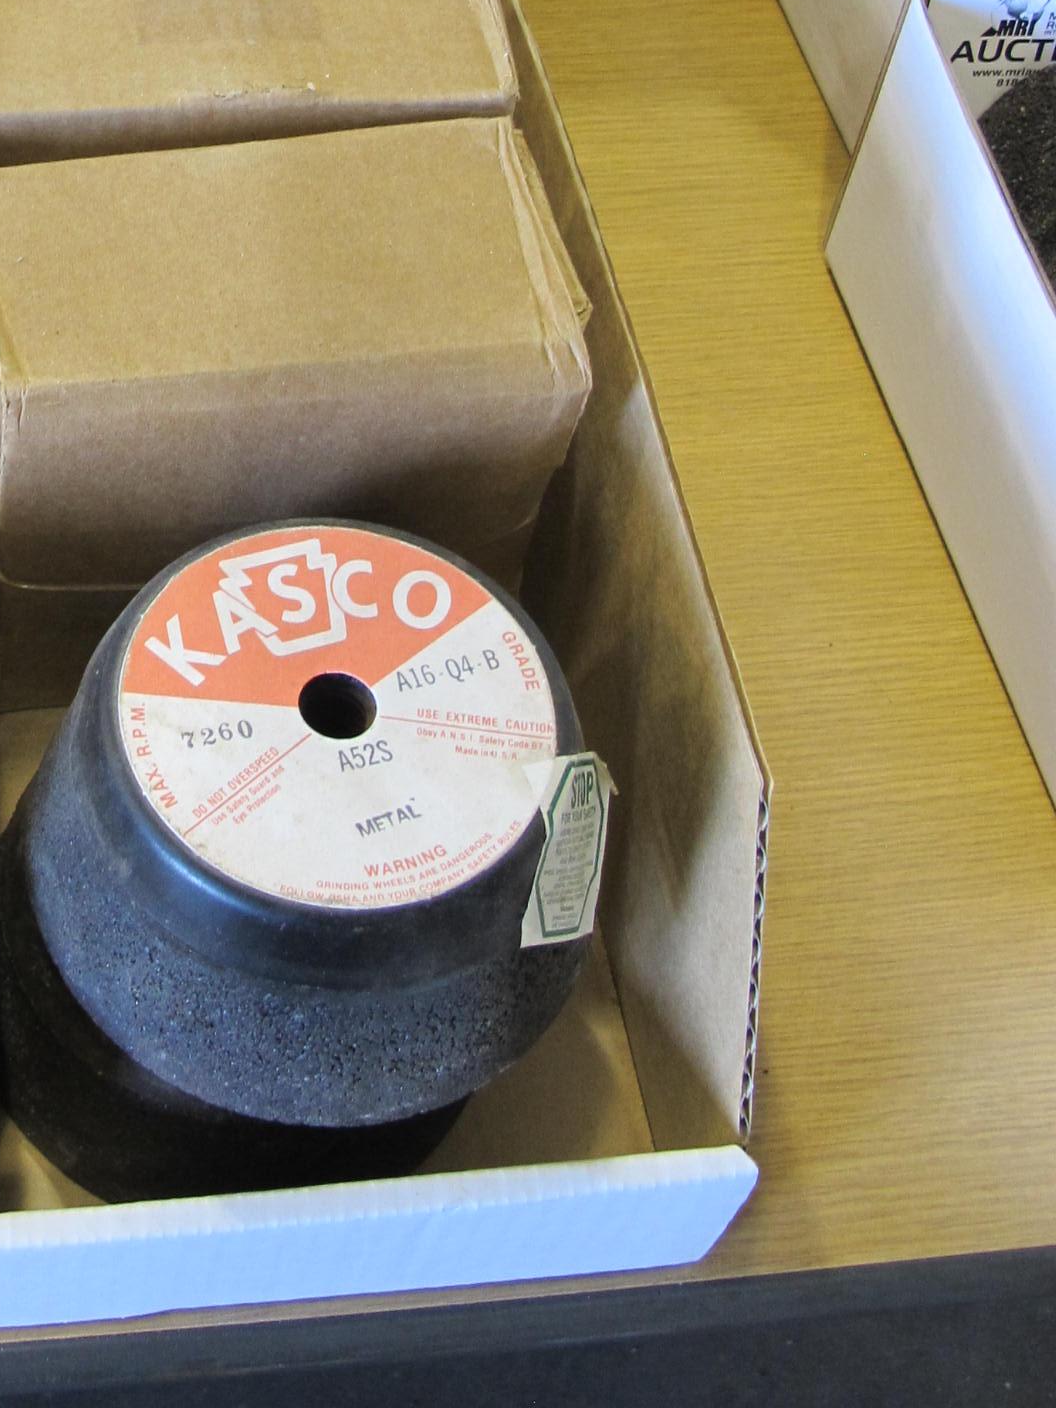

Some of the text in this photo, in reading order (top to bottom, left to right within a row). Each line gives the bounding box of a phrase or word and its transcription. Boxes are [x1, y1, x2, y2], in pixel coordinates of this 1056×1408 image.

[144, 554, 452, 687] KASCO
[501, 630, 541, 691] GRADE
[181, 719, 253, 749] 7260
[416, 708, 440, 720] USE
[446, 711, 499, 729] EXTREME
[336, 739, 395, 773] A52S
[192, 746, 281, 820] DO NOT OVERSPEED
[571, 771, 594, 810] STOP
[354, 803, 423, 838] METAL
[315, 831, 494, 891] GRINDING WHEELS ARE DANGEROUS
[362, 844, 448, 878] WARNING
[386, 887, 417, 902] YOUR
[418, 869, 467, 897] COMPANY
[467, 844, 500, 873] SAFETY
[496, 819, 523, 847] RULES
